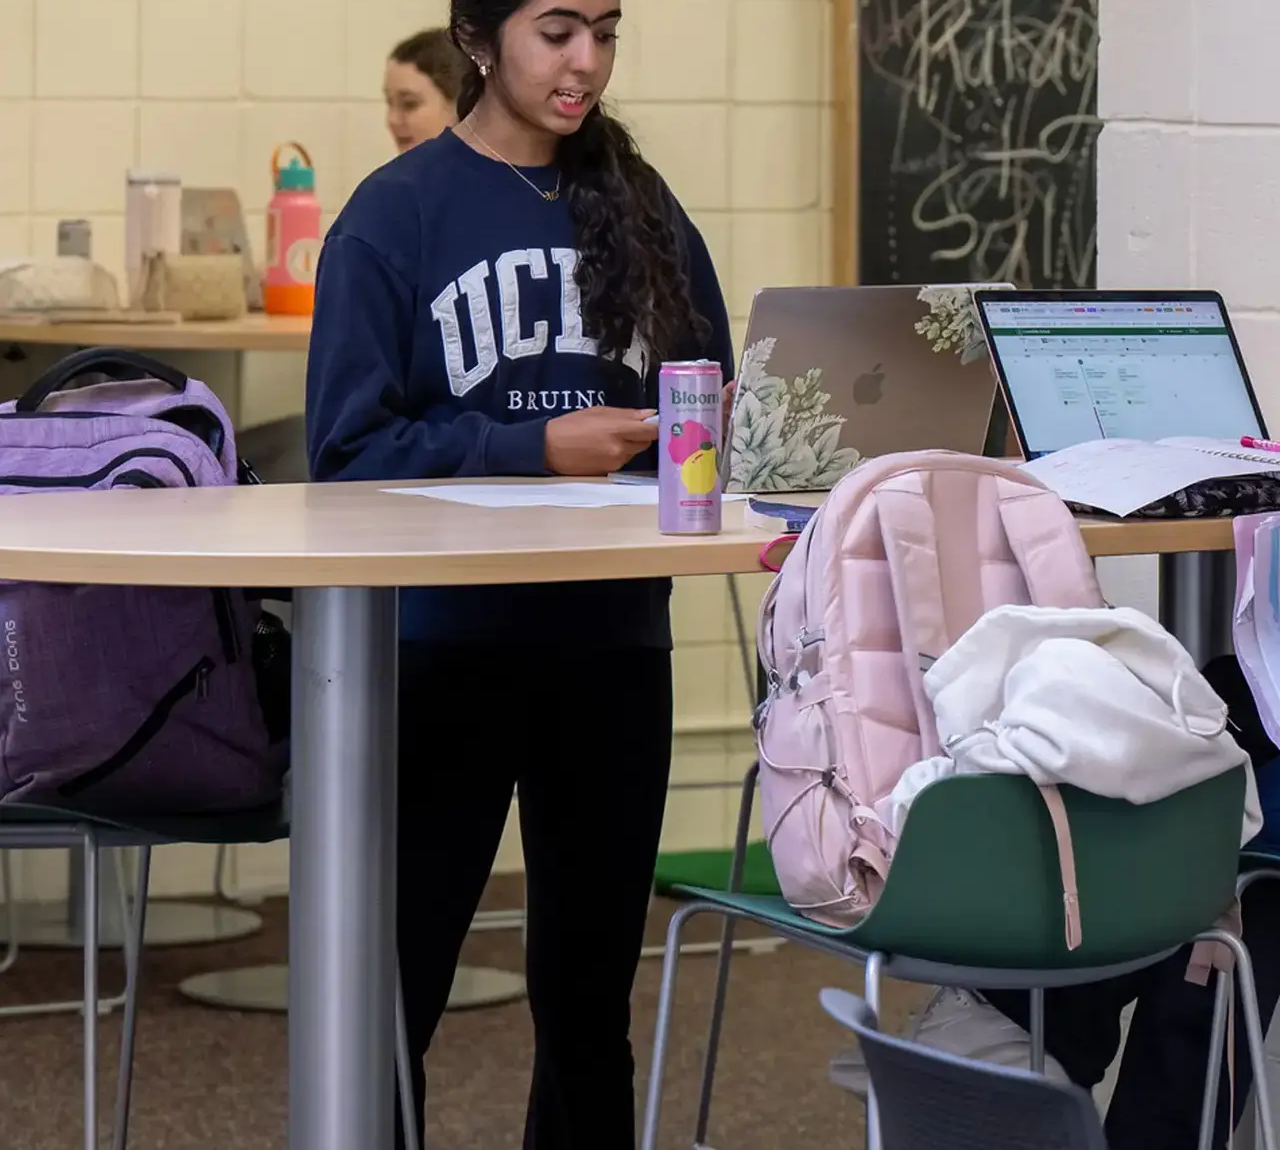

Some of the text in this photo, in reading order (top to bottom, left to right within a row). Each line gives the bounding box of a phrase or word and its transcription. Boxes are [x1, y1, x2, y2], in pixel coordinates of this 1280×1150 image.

[431, 248, 650, 397] UCL
[507, 390, 606, 411] BRUINS
[671, 387, 719, 405] Bloom
